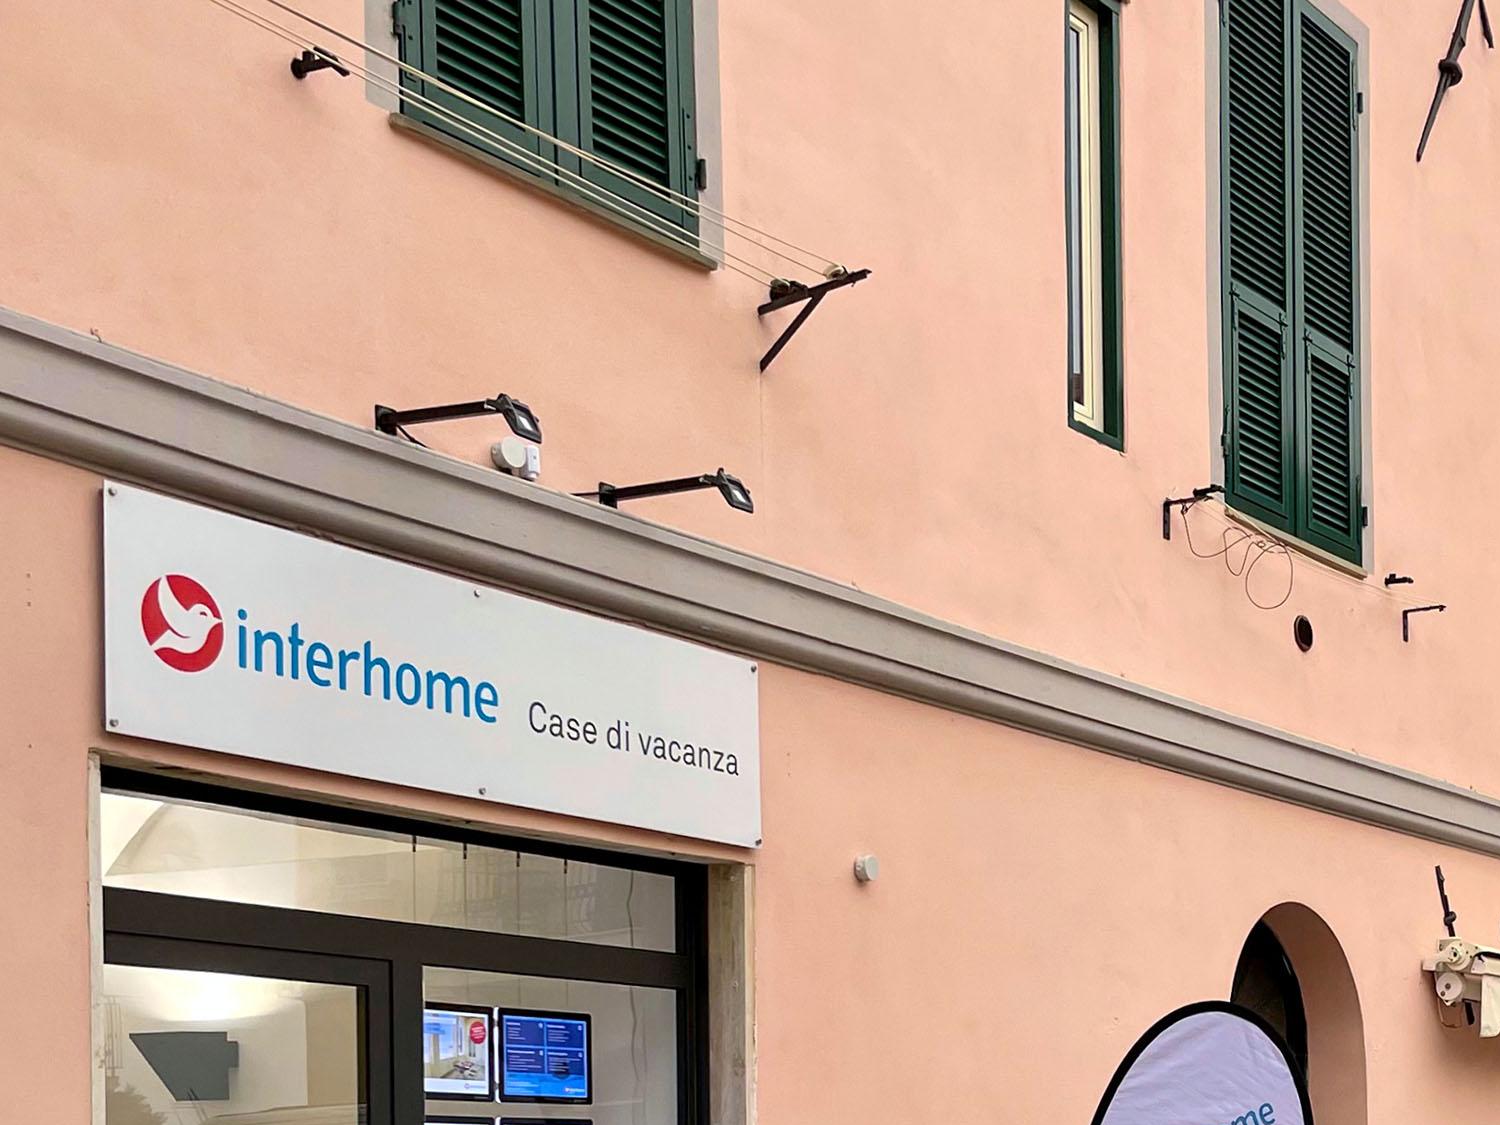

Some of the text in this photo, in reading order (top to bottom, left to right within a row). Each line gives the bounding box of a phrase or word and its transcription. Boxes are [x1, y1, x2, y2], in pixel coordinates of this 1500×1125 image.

[237, 608, 500, 724] interhome
[528, 701, 740, 777] Case di vacanza
